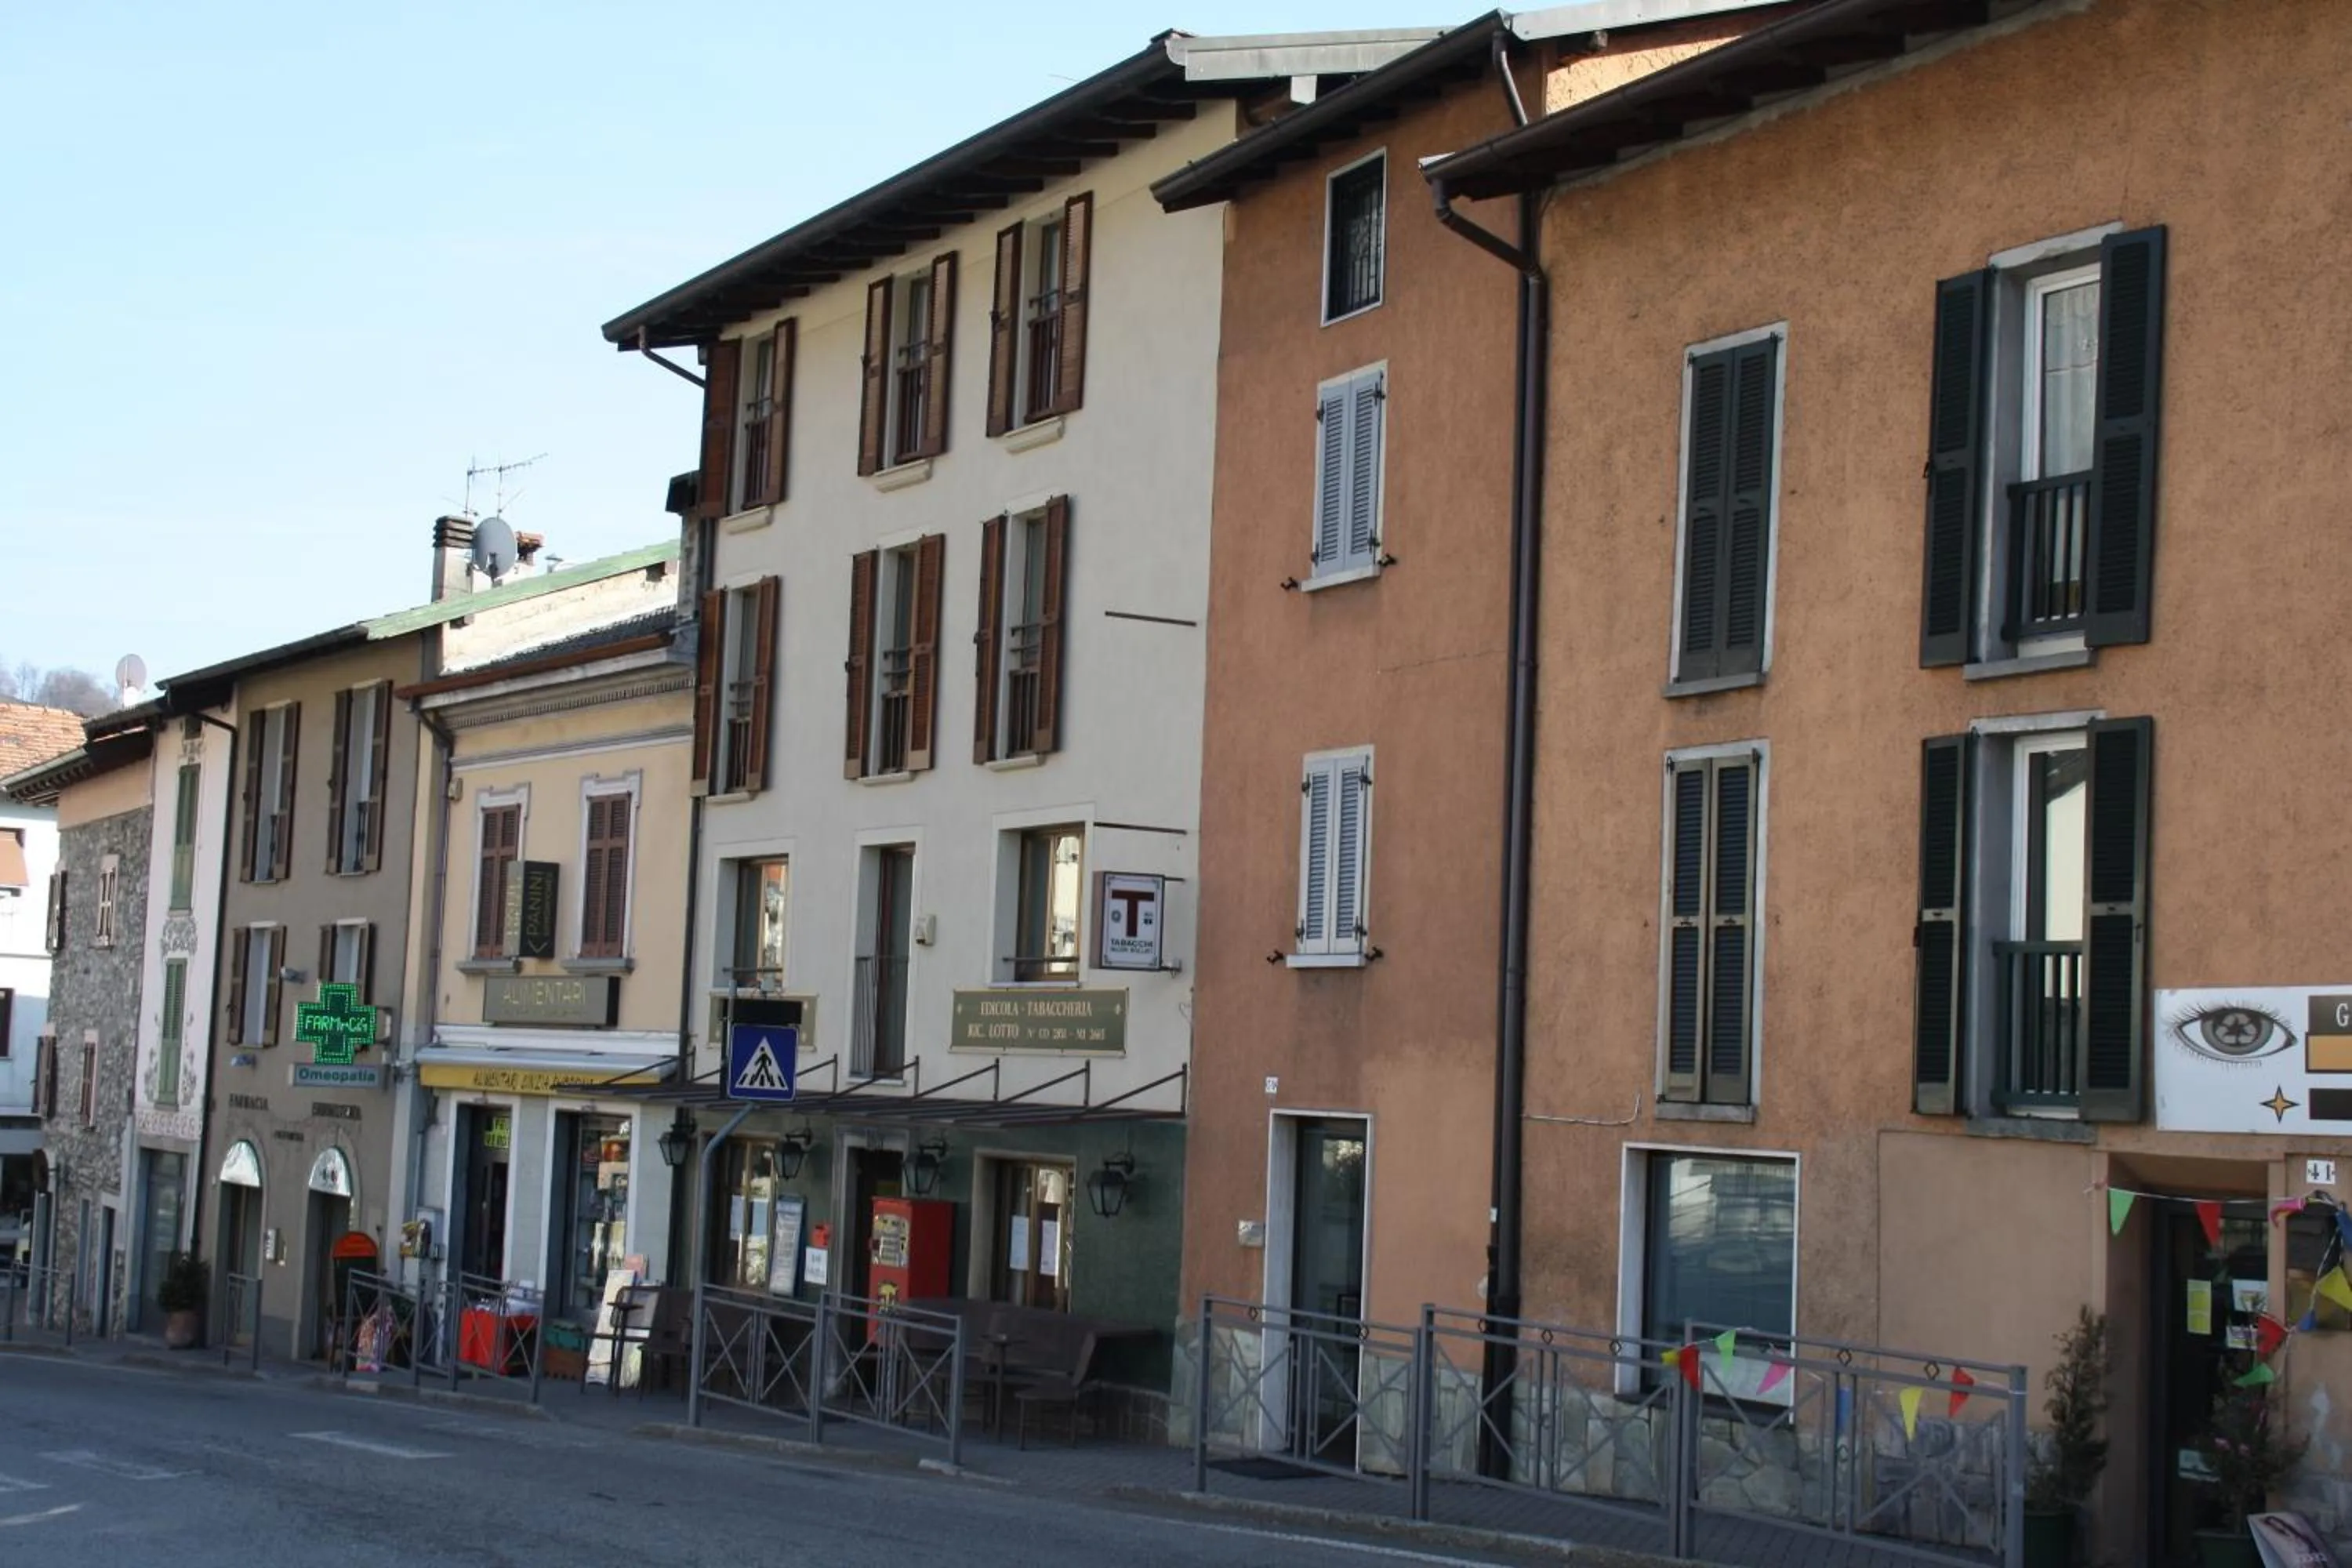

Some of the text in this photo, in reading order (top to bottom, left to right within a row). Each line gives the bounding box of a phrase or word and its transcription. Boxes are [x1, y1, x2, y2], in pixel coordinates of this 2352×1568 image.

[1111, 889, 1155, 938] T
[503, 980, 586, 1005] ALIMENTARI
[1027, 1000, 1092, 1017] TABACCHERIA
[989, 1022, 1019, 1039] LOTTO
[299, 1068, 376, 1083] Omeopatia
